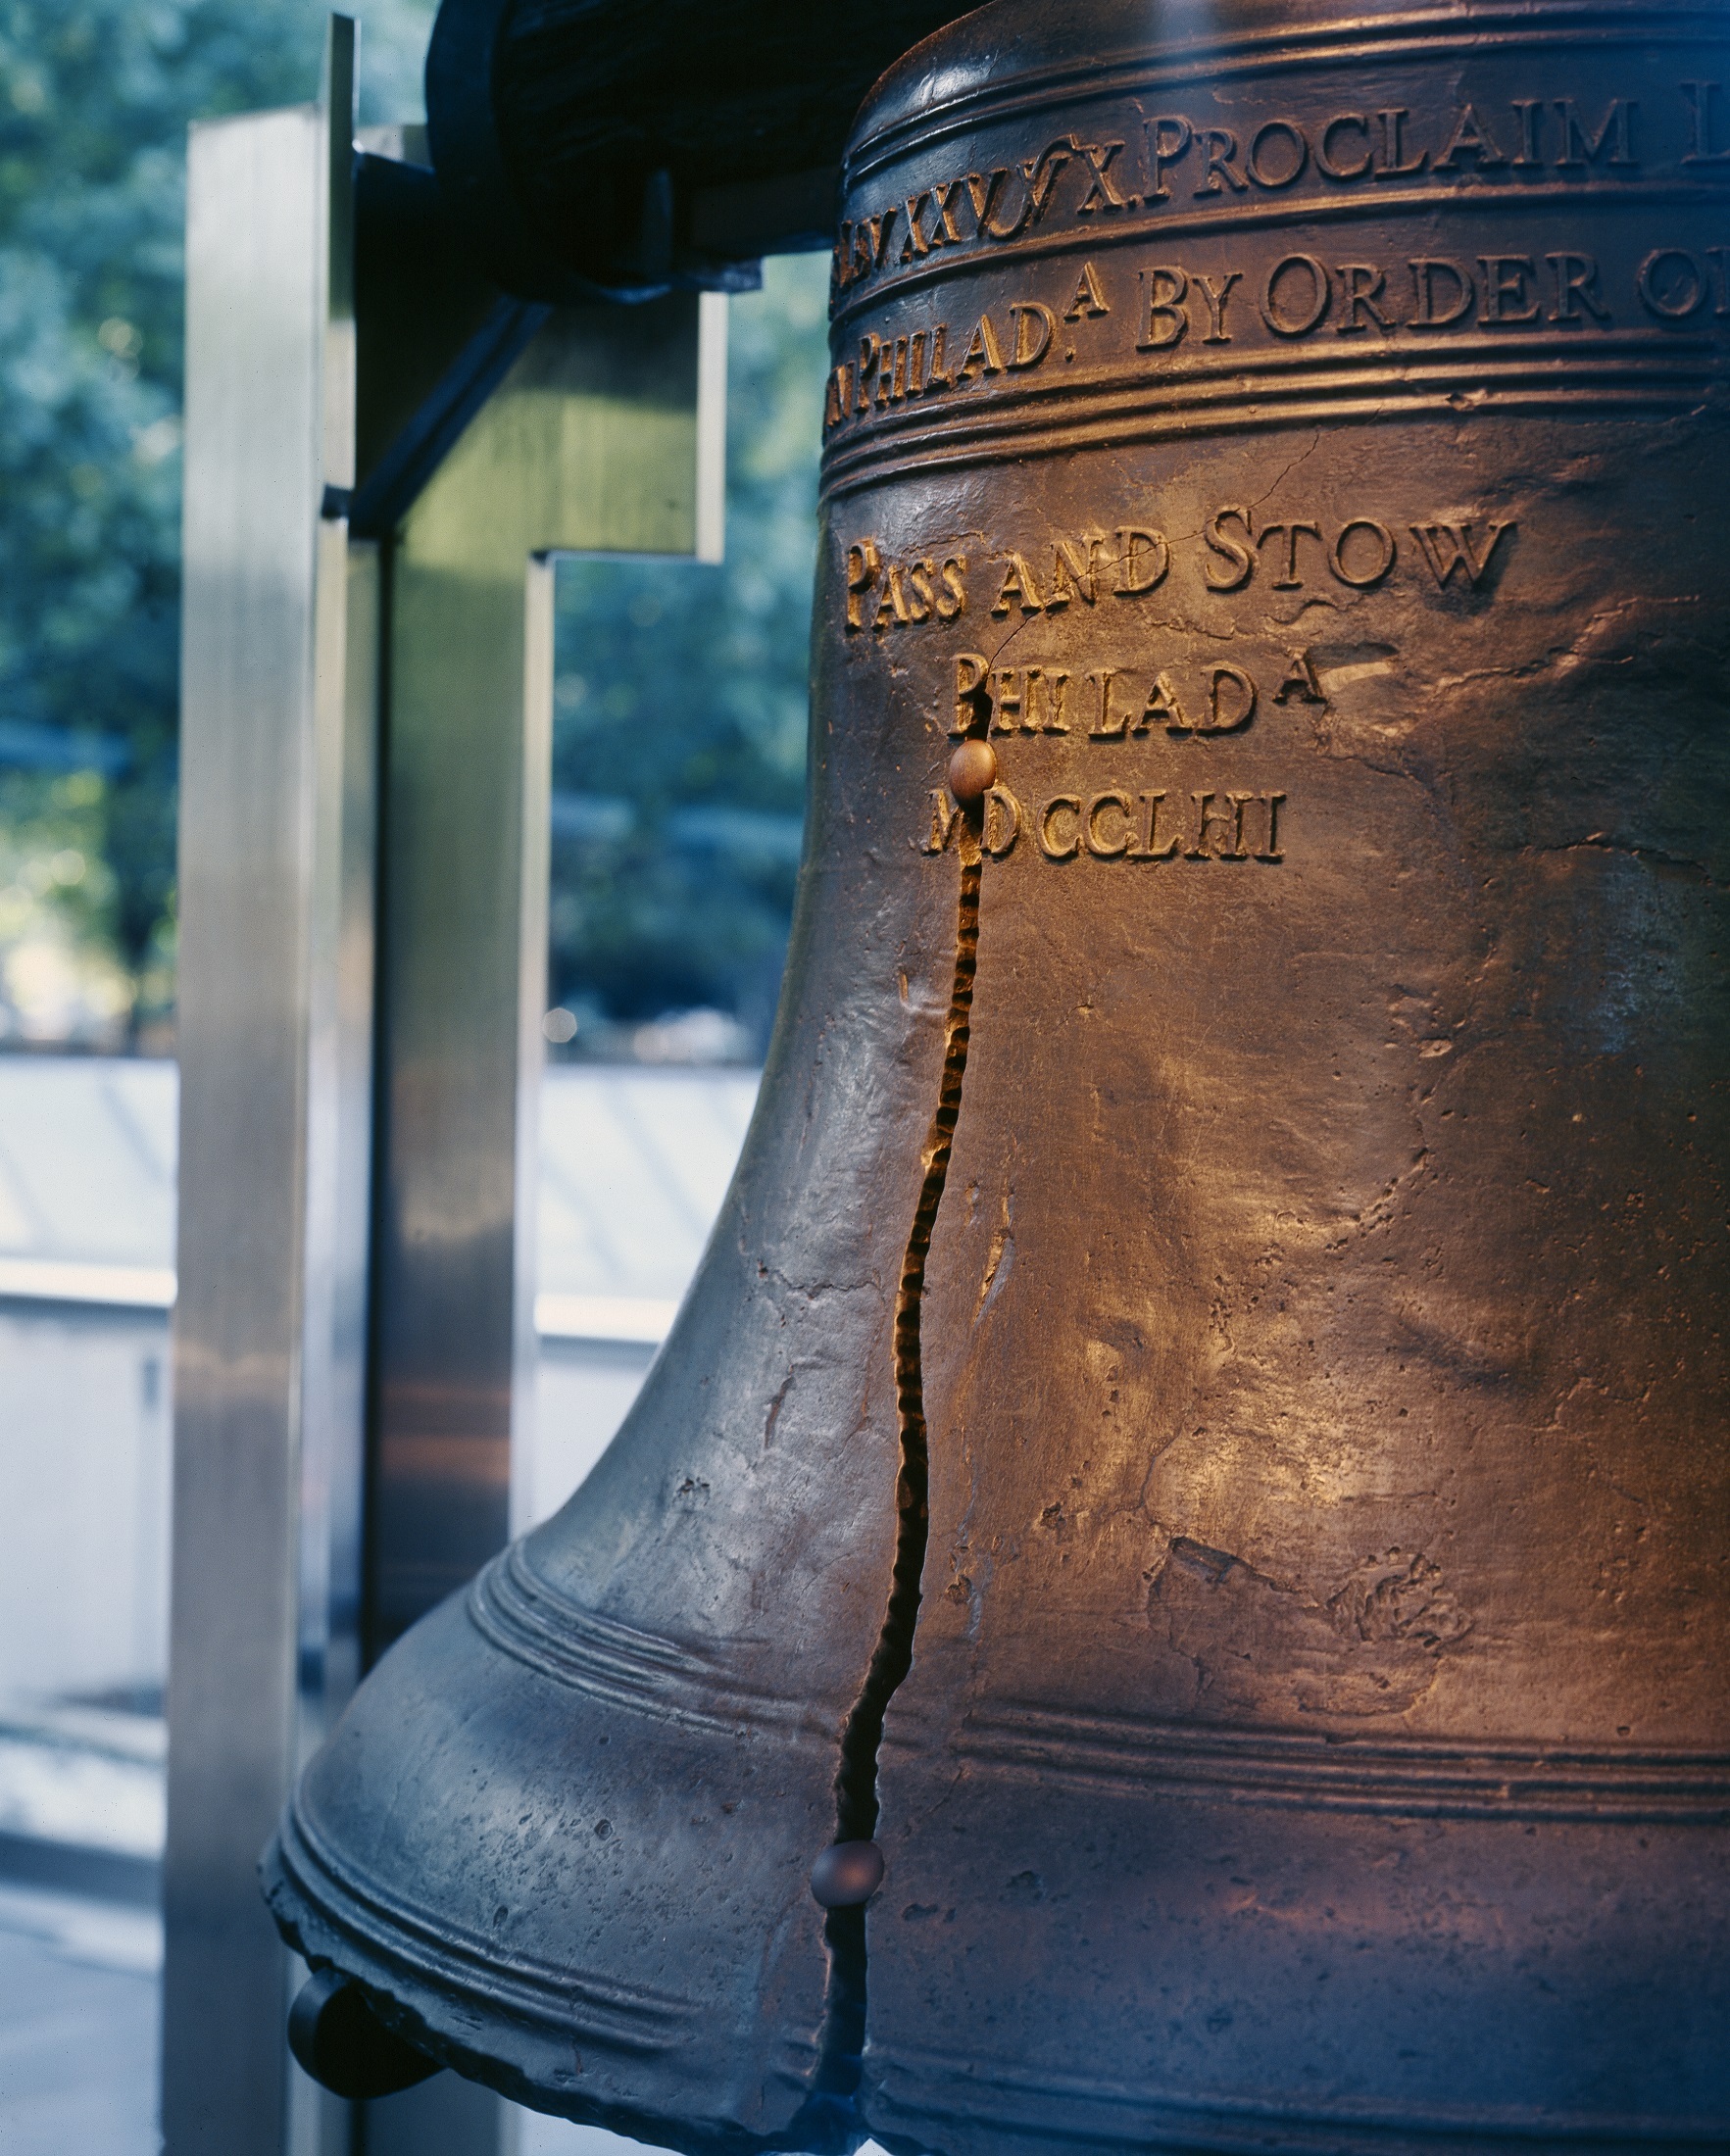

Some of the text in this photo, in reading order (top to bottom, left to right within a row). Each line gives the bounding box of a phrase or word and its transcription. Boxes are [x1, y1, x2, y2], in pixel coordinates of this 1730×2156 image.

[1140, 99, 1639, 202] PROCLAIM
[1134, 266, 1244, 353] BY
[1260, 251, 1612, 339] ORDER
[844, 506, 1519, 633] PASS AND STOW
